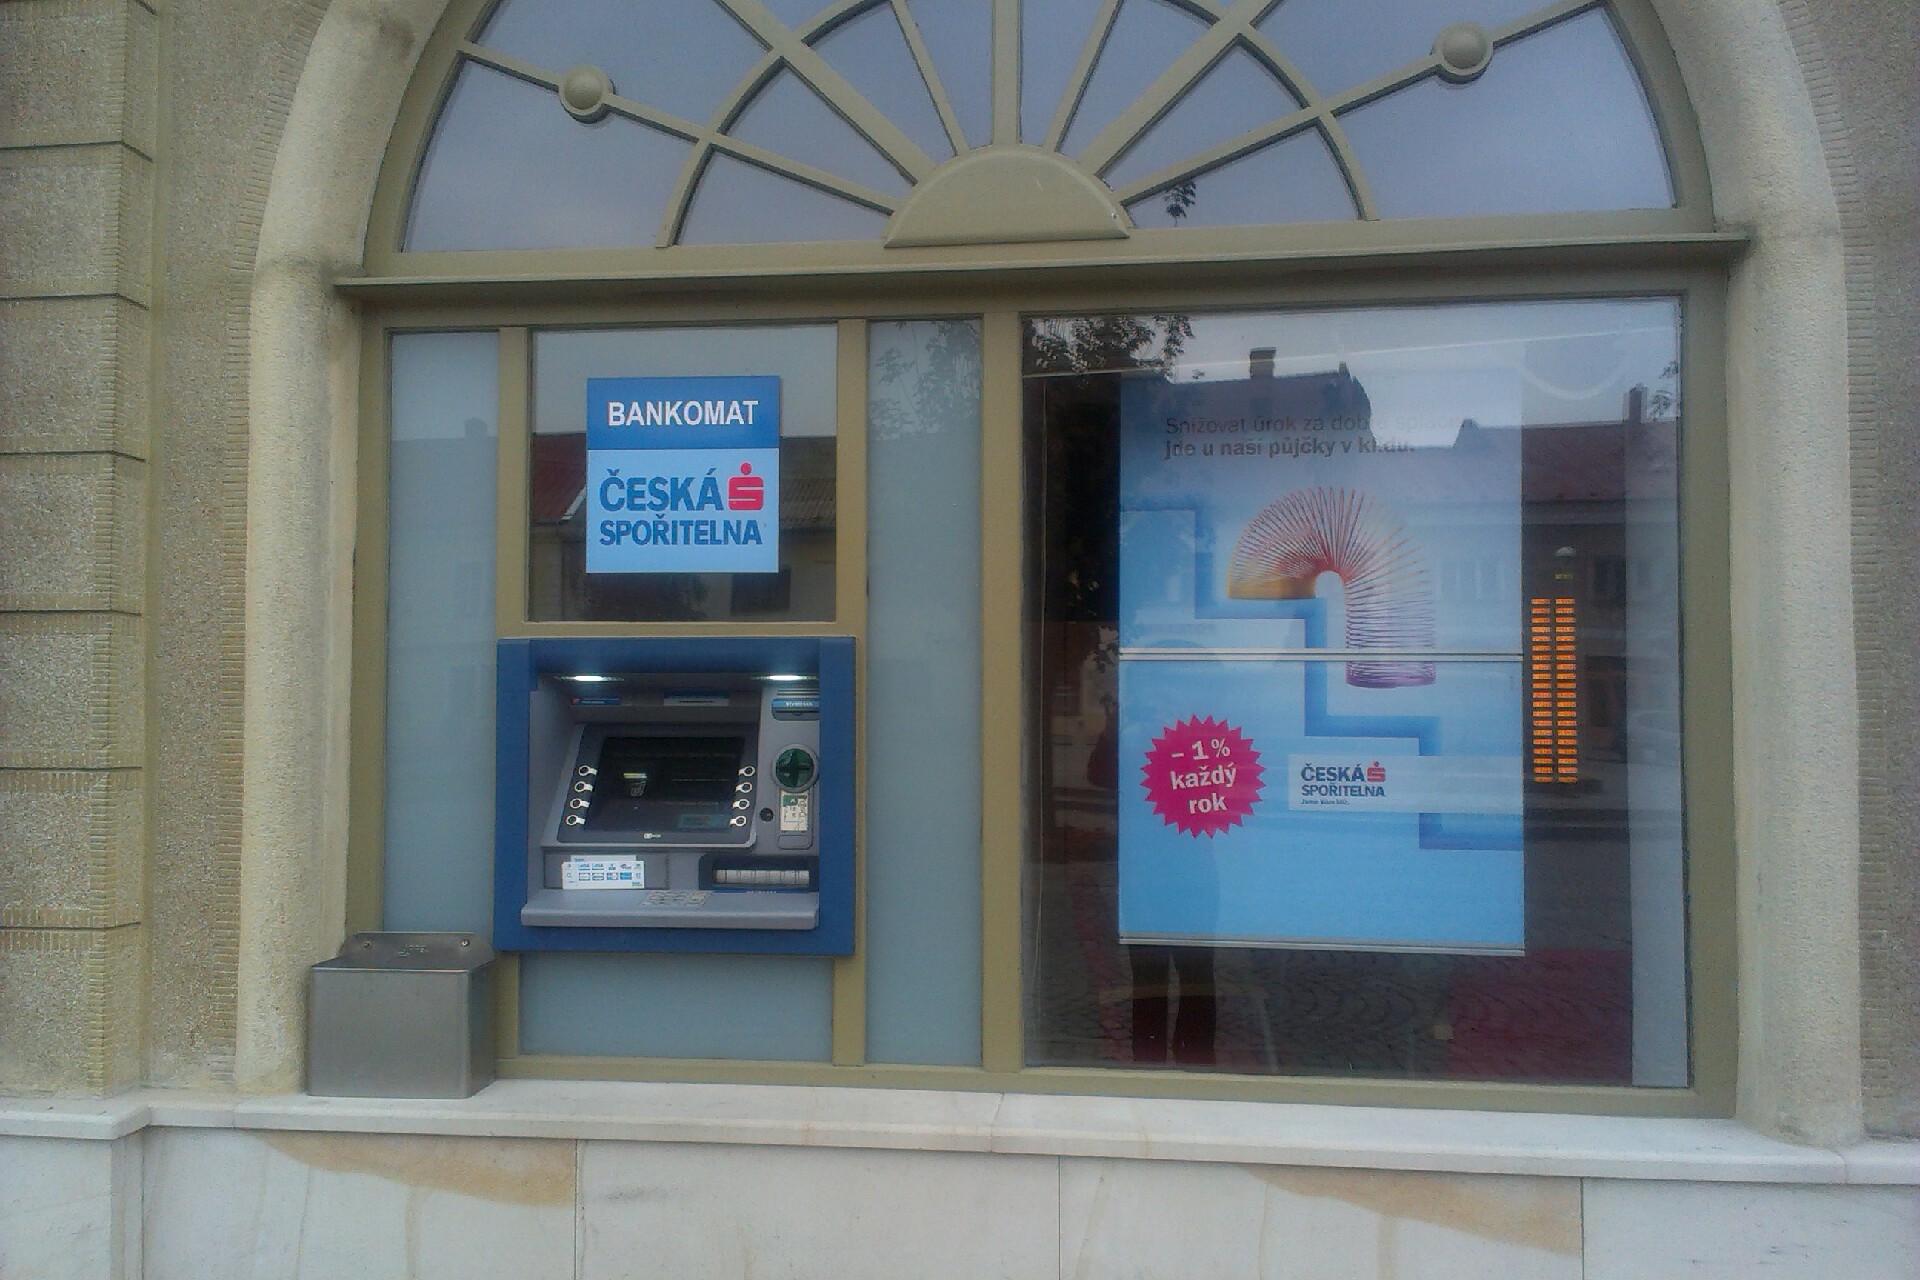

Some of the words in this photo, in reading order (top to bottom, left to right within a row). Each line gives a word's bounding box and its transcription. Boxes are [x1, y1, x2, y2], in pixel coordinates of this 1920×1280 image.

[607, 400, 759, 426] BANKOMAT
[1166, 416, 1247, 434] Snižovat
[1254, 416, 1297, 433] úrok
[1303, 417, 1325, 432] za
[1163, 439, 1197, 461] jde
[1202, 442, 1214, 456] u
[1219, 437, 1262, 456] naší
[1268, 436, 1336, 459] půjčky
[1341, 440, 1353, 454] v
[599, 467, 725, 512] ČESKÁ
[599, 513, 763, 546] SPOŘITELNA
[1169, 762, 1237, 790] každý
[1301, 762, 1366, 782] ČESKÁ
[1301, 782, 1386, 798] SPOŘITELNA
[1188, 792, 1228, 814] rok
